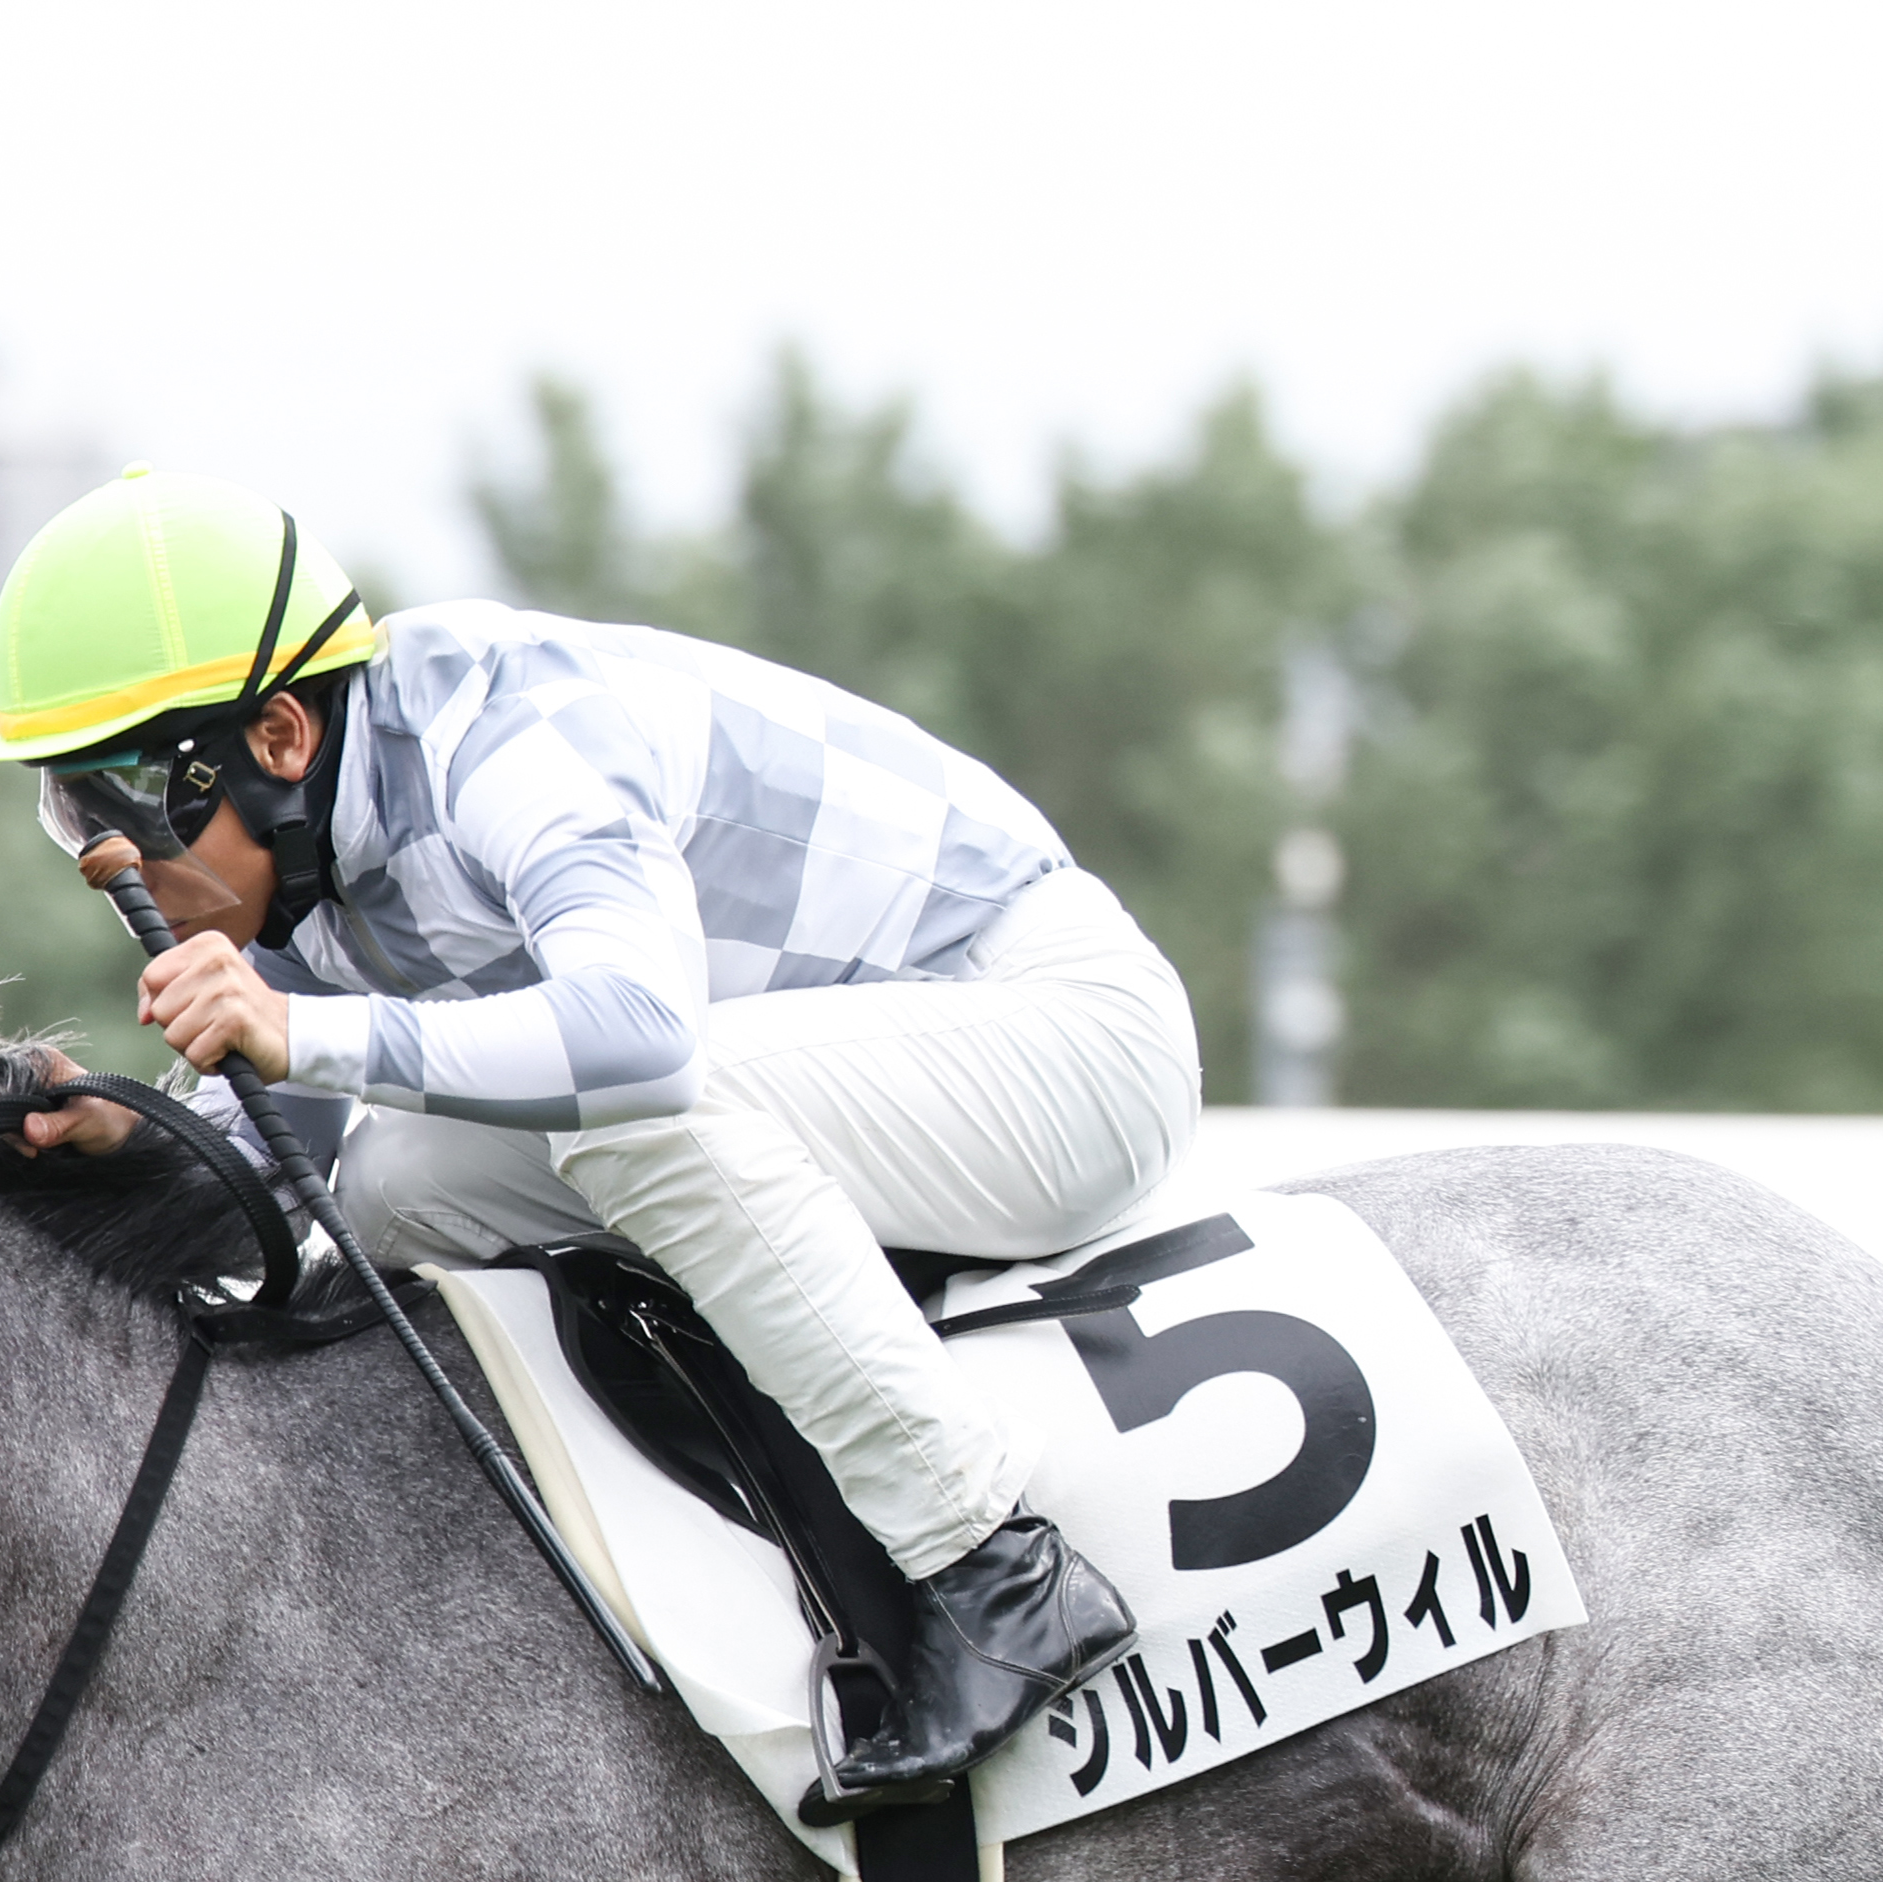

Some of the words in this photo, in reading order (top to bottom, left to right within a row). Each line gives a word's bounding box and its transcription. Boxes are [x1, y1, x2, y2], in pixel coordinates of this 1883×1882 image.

[1028, 1211, 1377, 1572] 5
[1047, 1513, 1531, 1798] シルバーウィル
